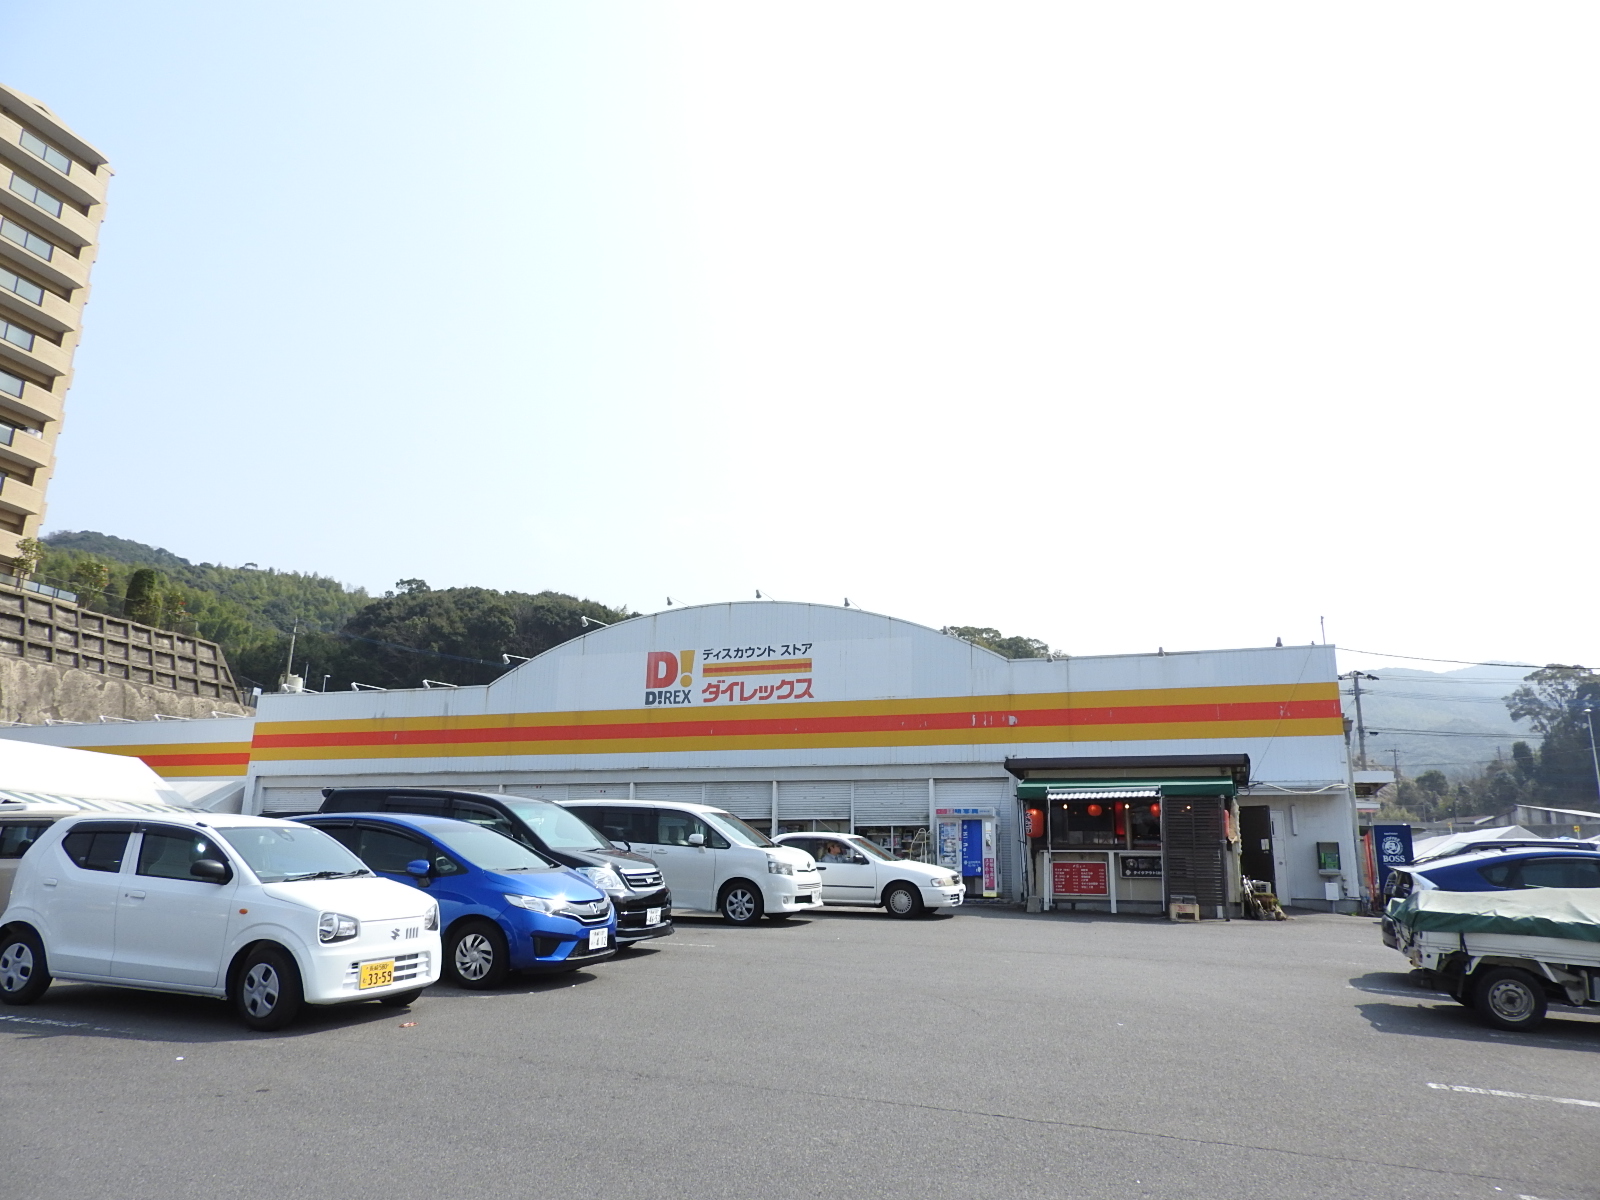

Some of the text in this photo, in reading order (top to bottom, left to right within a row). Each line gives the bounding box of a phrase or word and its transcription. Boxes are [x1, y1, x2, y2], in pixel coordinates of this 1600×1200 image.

[703, 643, 812, 660] ディスカウント ストア
[702, 678, 814, 703] ダイレックス
[367, 970, 392, 986] 33-59
